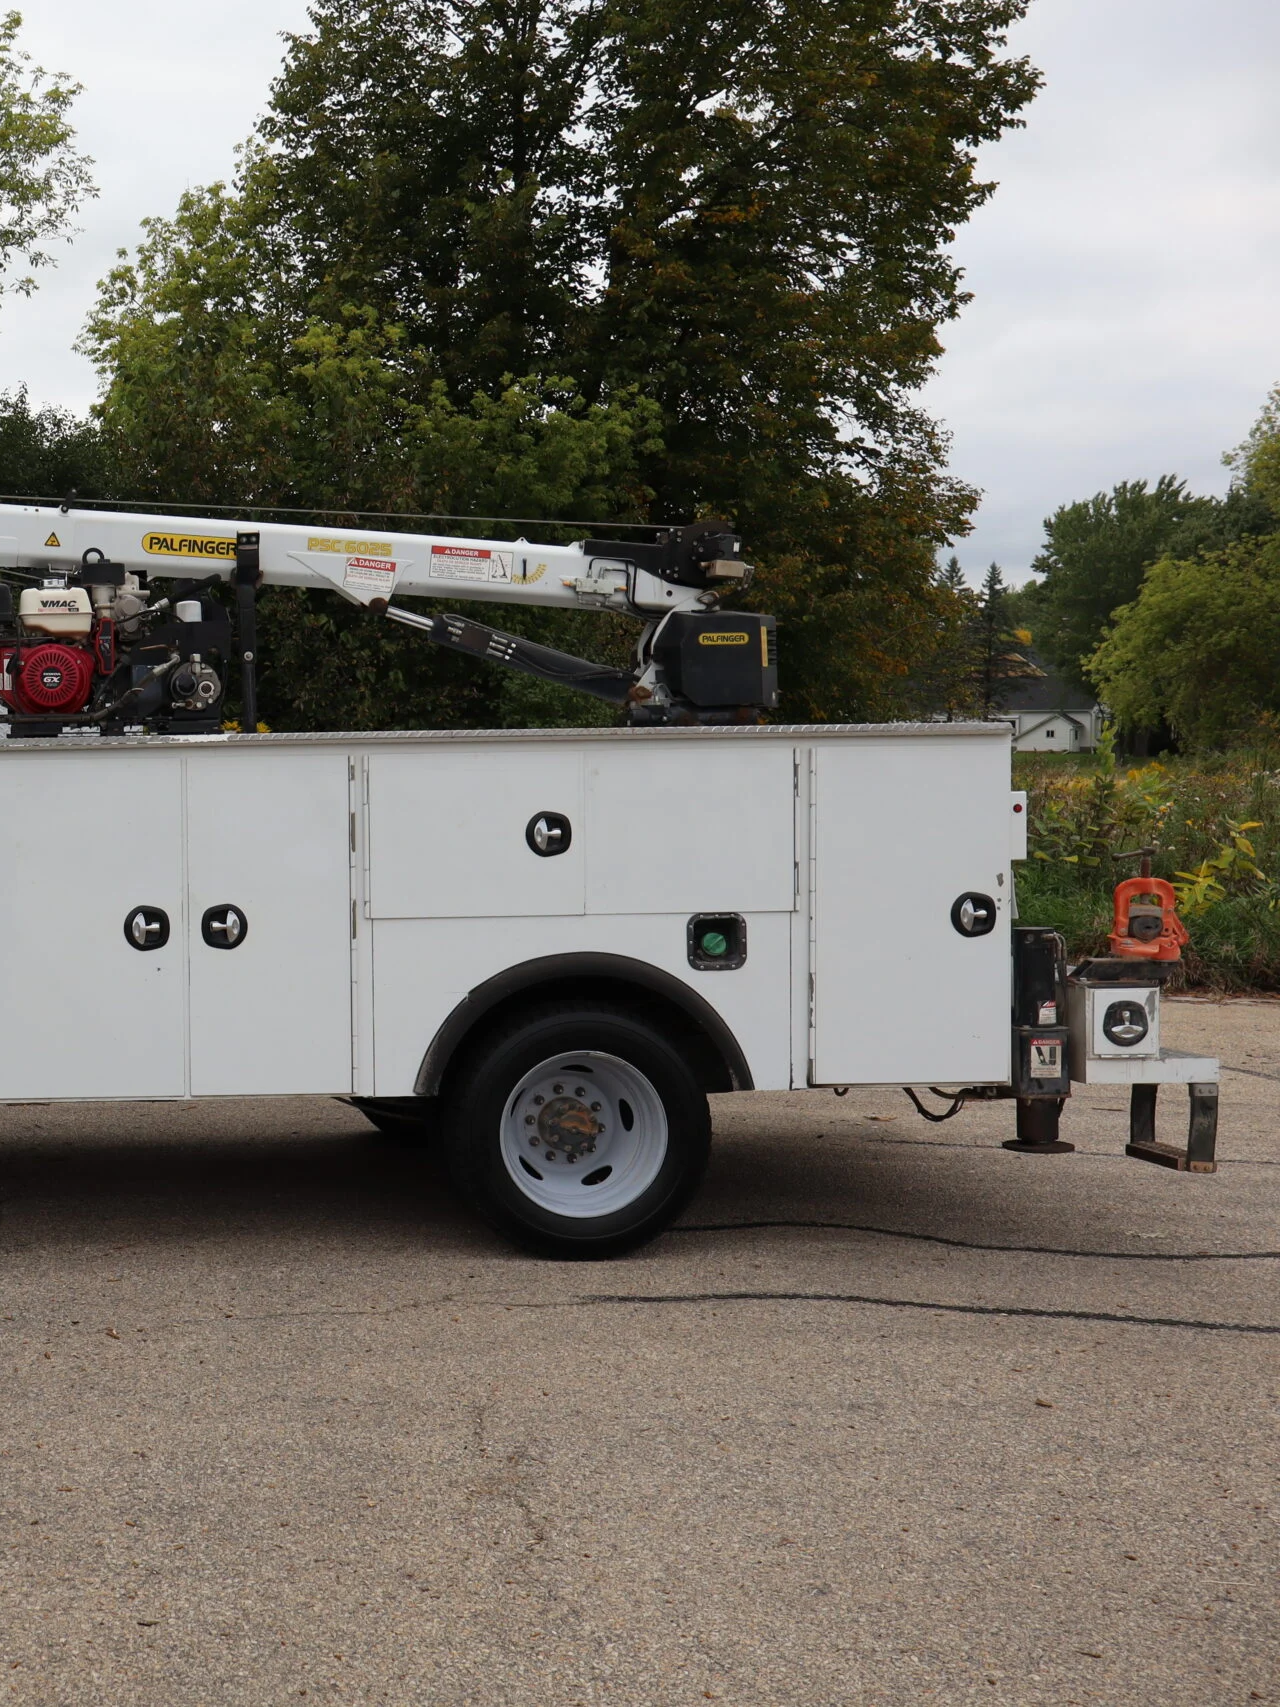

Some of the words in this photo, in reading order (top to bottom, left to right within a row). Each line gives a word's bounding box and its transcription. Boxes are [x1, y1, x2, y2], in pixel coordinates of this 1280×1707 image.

[149, 536, 237, 556] PALFINGER
[308, 537, 341, 552] PSC
[345, 541, 392, 556] 6025
[451, 548, 479, 557] DANGER
[359, 559, 391, 570] DANGER
[40, 600, 77, 608] VMAC
[702, 635, 745, 643] PALFINGER
